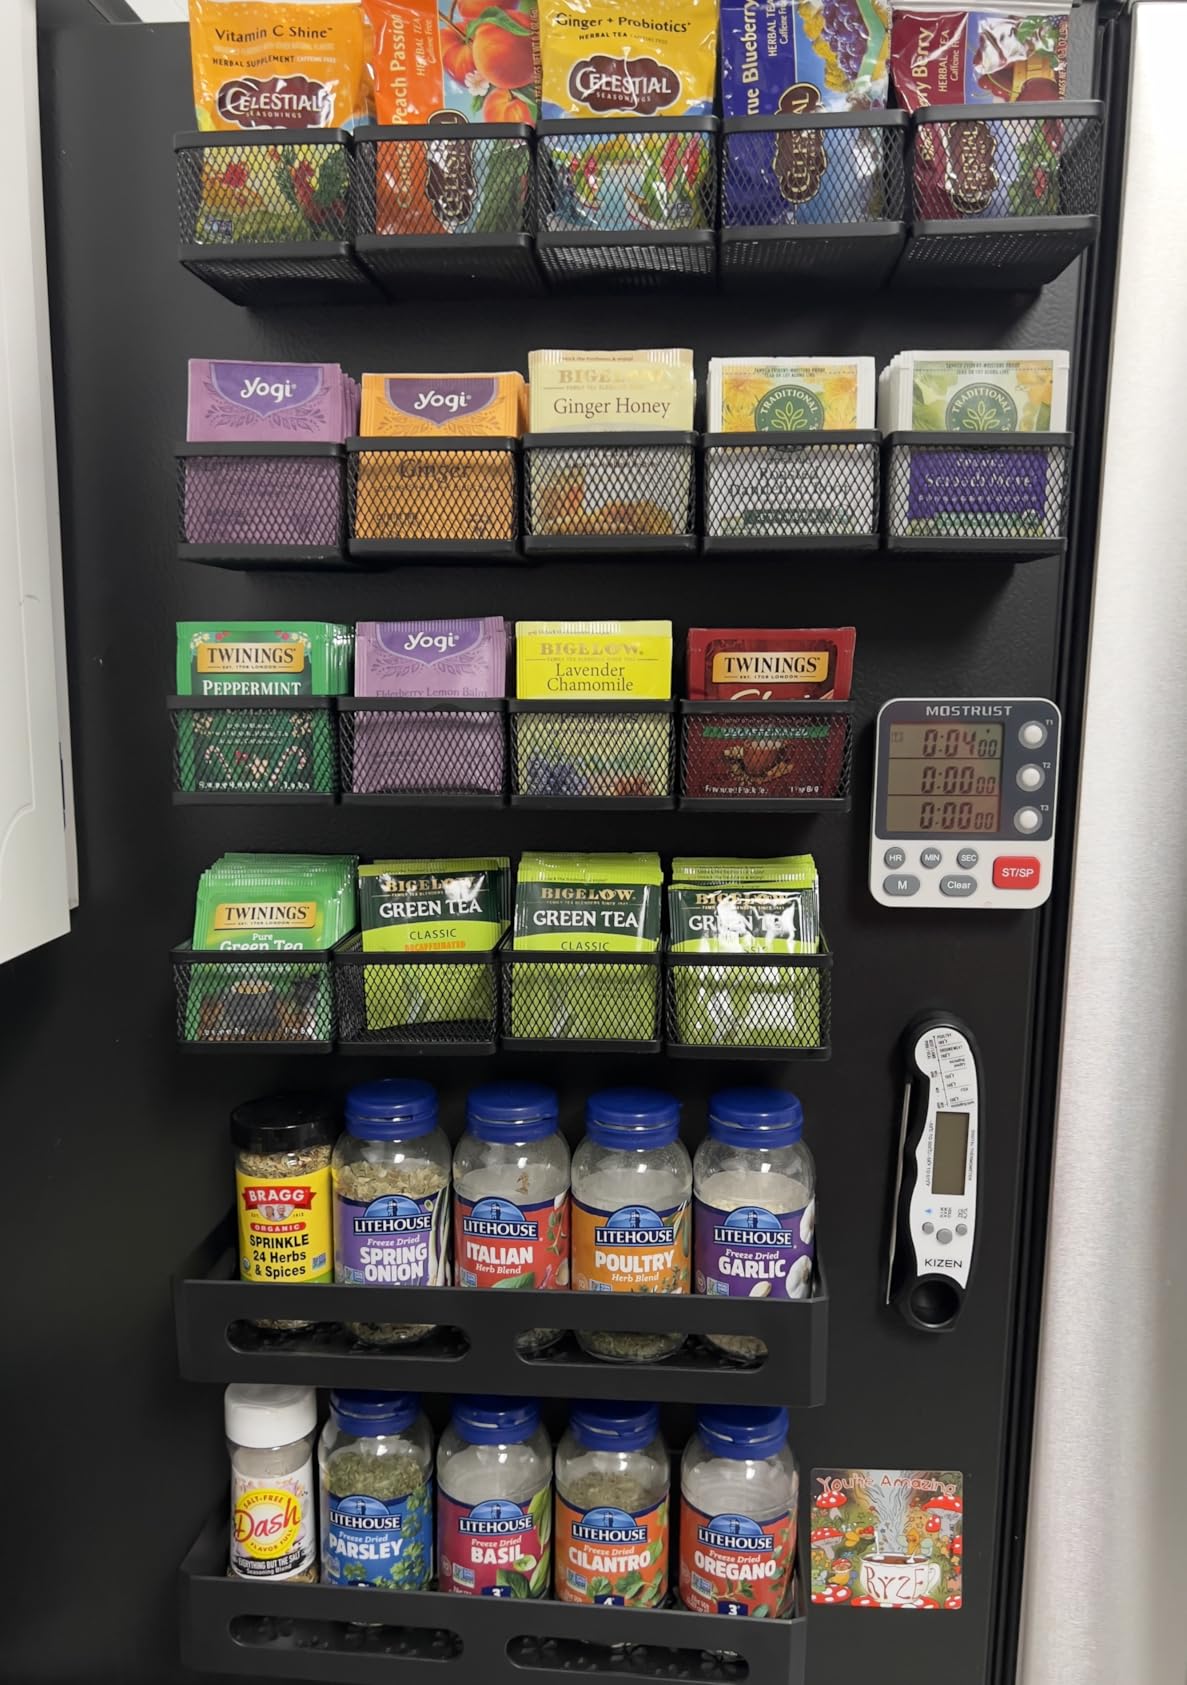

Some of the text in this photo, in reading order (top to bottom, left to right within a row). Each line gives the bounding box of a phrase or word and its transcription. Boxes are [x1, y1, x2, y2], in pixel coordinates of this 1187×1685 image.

[556, 12, 603, 30] Ginger
[618, 16, 688, 33] Probiotics
[779, 15, 789, 45] Caffeine
[215, 24, 328, 43] Vitamin C Shine
[579, 31, 610, 40] HERBAL
[767, 19, 778, 57] HERBAL
[389, 14, 407, 73] Passion
[212, 57, 244, 67] HERBAL
[246, 55, 295, 67] SUPPLEMENT
[740, 0, 760, 116] rue Blueberry
[911, 28, 934, 78] Berry
[950, 49, 961, 82] Caffeine
[575, 66, 672, 97] CELESTIAL
[938, 55, 948, 93] HERBAL
[225, 87, 322, 115] CELESTIAL
[389, 76, 408, 125] Peach
[245, 111, 303, 119] SEASONINGS
[559, 369, 664, 384] BIGEL
[760, 388, 820, 415] TRADITIONAL
[952, 387, 1012, 413] TRADITIONAL
[553, 397, 671, 420] Ginger Honey
[207, 647, 293, 665] TWININGS
[556, 662, 626, 677] Lavender
[724, 656, 818, 674] TWININGS
[202, 679, 302, 696] PEPPERMINT
[426, 686, 460, 698] Lemon
[462, 687, 488, 698] Balm
[546, 677, 634, 693] Chamomile
[925, 705, 1013, 717] MOSTRUST
[888, 854, 902, 862] HR
[924, 854, 940, 862] MIN
[960, 854, 977, 863] SEC
[1001, 866, 1035, 878] ST/SP
[897, 880, 908, 890] M
[947, 880, 971, 890] Clear
[541, 887, 635, 901] BIGELOW
[224, 905, 308, 921] TWININGS
[379, 898, 484, 918] GREEN TEA
[533, 910, 639, 928] GREEN TEA
[688, 915, 754, 931] GRN
[252, 932, 273, 942] Pure
[409, 928, 457, 941] CLASSIC
[220, 940, 304, 951] Green Tea
[560, 941, 610, 951] CLASSIC
[248, 1189, 305, 1202] BRAGG
[254, 1223, 300, 1232] ORGANIC
[354, 1216, 432, 1233] LITEHOUSE
[463, 1219, 537, 1238] LITEHOUSE
[249, 1234, 310, 1249] SPRINKLE
[367, 1234, 420, 1246] Freeze Dried
[596, 1230, 673, 1244] LITEHOUSE
[714, 1228, 792, 1245] LITEHOUSE
[252, 1250, 306, 1264] 24 Herbs
[360, 1242, 428, 1266] SPRING
[466, 1240, 534, 1265] ITALIAN
[725, 1248, 780, 1260] Freeze Dried
[476, 1263, 522, 1275] Herb Blend
[594, 1249, 675, 1274] POULTRY
[718, 1256, 787, 1279] GARLIC
[924, 1258, 964, 1268] KIZEN
[255, 1264, 306, 1280] & Spices
[364, 1260, 424, 1283] ONION
[612, 1272, 660, 1283] Herb Blend
[816, 1472, 958, 1497] You're Amazing
[243, 1494, 284, 1509] SALT-FREE
[234, 1497, 301, 1544] Dash
[329, 1511, 401, 1530] LITEHOUSE
[459, 1516, 532, 1533] LITEHOUSE
[338, 1530, 388, 1544] Freeze Dried
[471, 1534, 522, 1548] Freeze Dried
[572, 1524, 647, 1542] LITEHOUSE
[698, 1528, 773, 1550] LITEHOUSE
[250, 1542, 278, 1552] FLAVOR
[328, 1532, 404, 1560] PARSLEY
[583, 1544, 635, 1556] Freeze Dried
[470, 1544, 525, 1565] BASIL
[568, 1546, 652, 1574] CILANTRO
[708, 1550, 761, 1564] Freeze Dried
[694, 1550, 777, 1581] OREGANO
[864, 1565, 925, 1600] RYZE
[728, 1604, 738, 1616] 3
